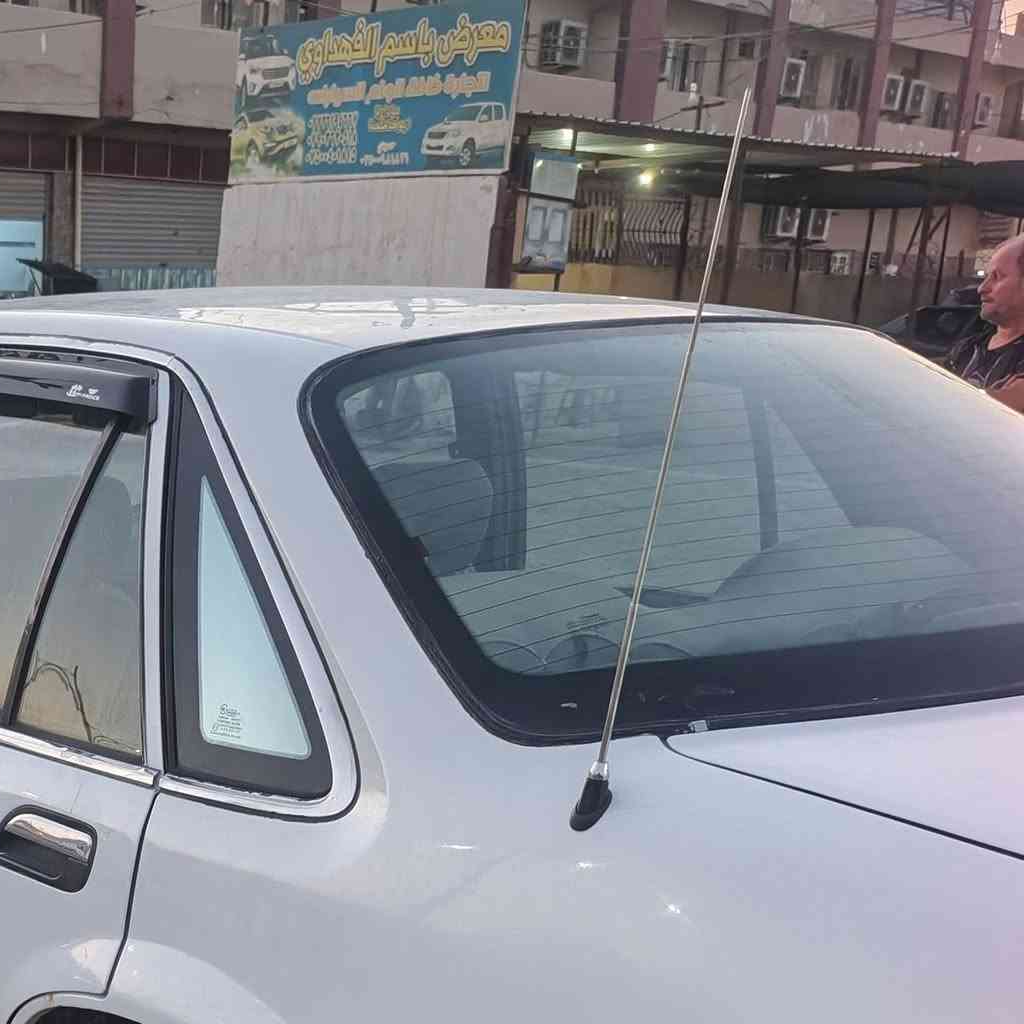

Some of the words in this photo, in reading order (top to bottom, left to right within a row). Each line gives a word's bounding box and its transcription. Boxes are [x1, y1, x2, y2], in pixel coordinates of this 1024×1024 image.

[297, 17, 381, 85] الفهداوي
[375, 17, 436, 77] باسم
[436, 12, 511, 67] معرض
